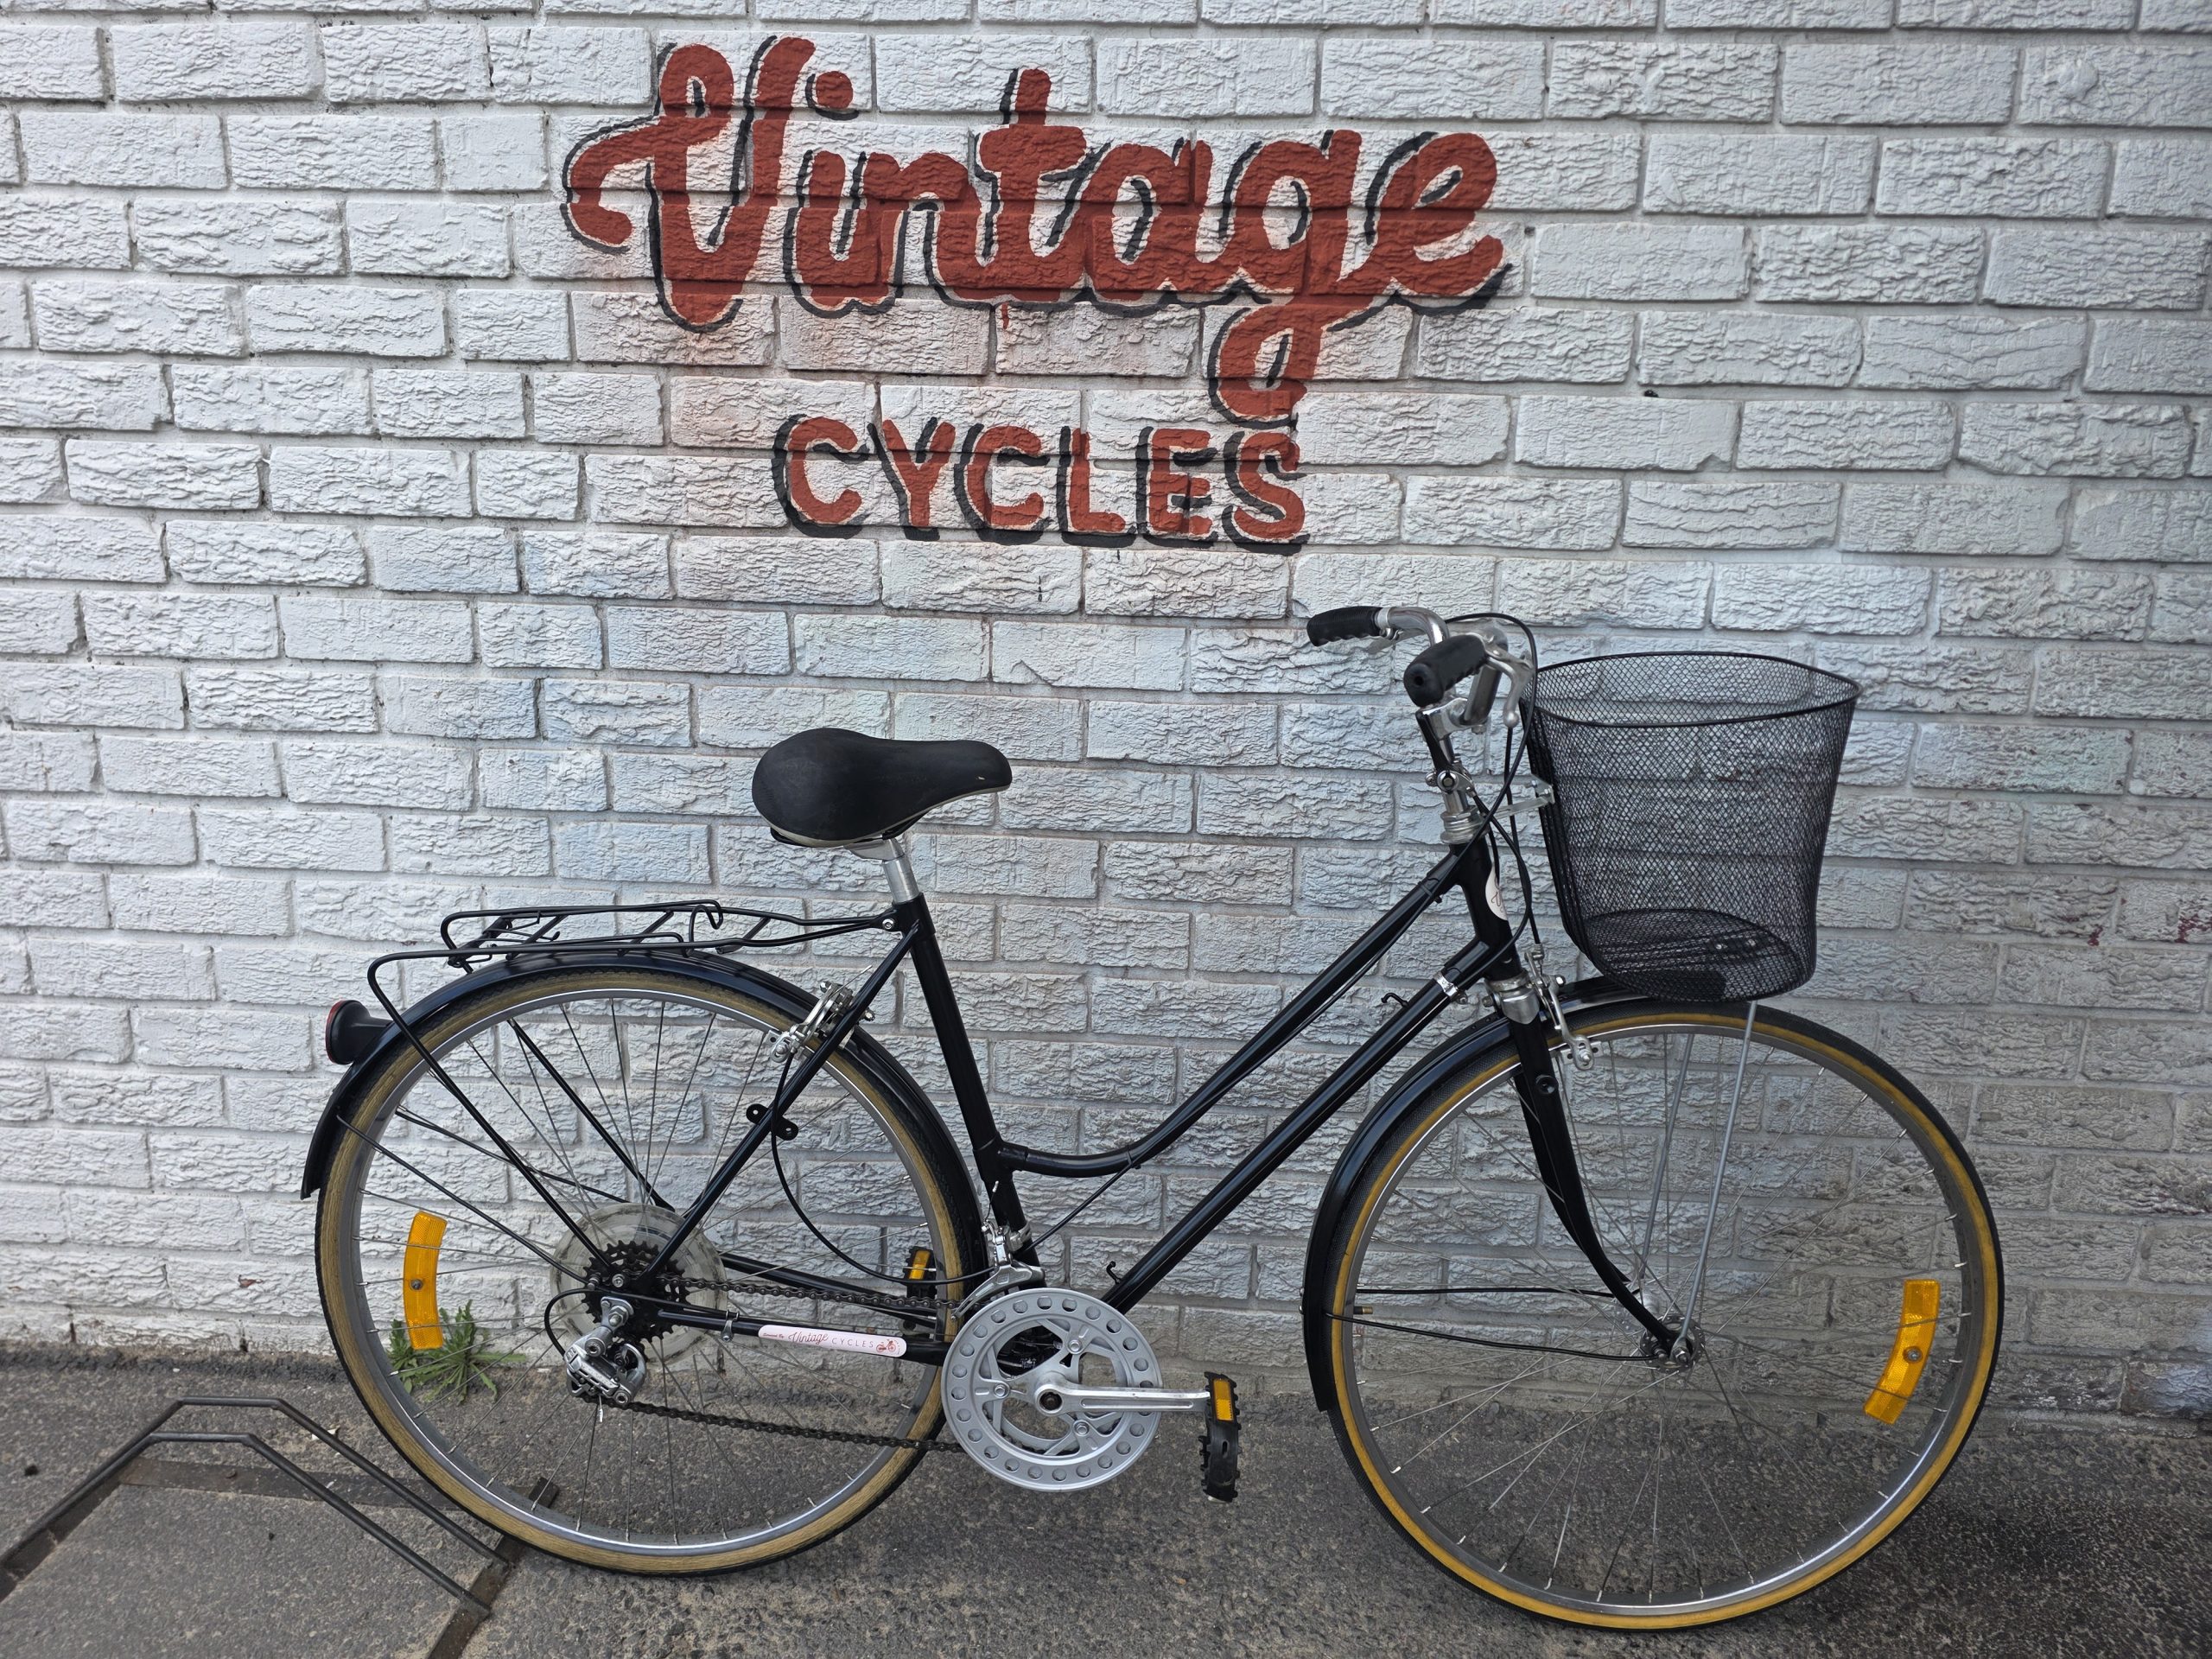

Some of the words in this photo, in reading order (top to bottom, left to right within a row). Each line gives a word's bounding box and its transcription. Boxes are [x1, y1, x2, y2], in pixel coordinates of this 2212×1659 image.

[562, 35, 1513, 427] Vintage
[772, 413, 1308, 554] CYCLES
[788, 1332, 829, 1345] Vintage
[831, 1338, 874, 1348] CYCLES
